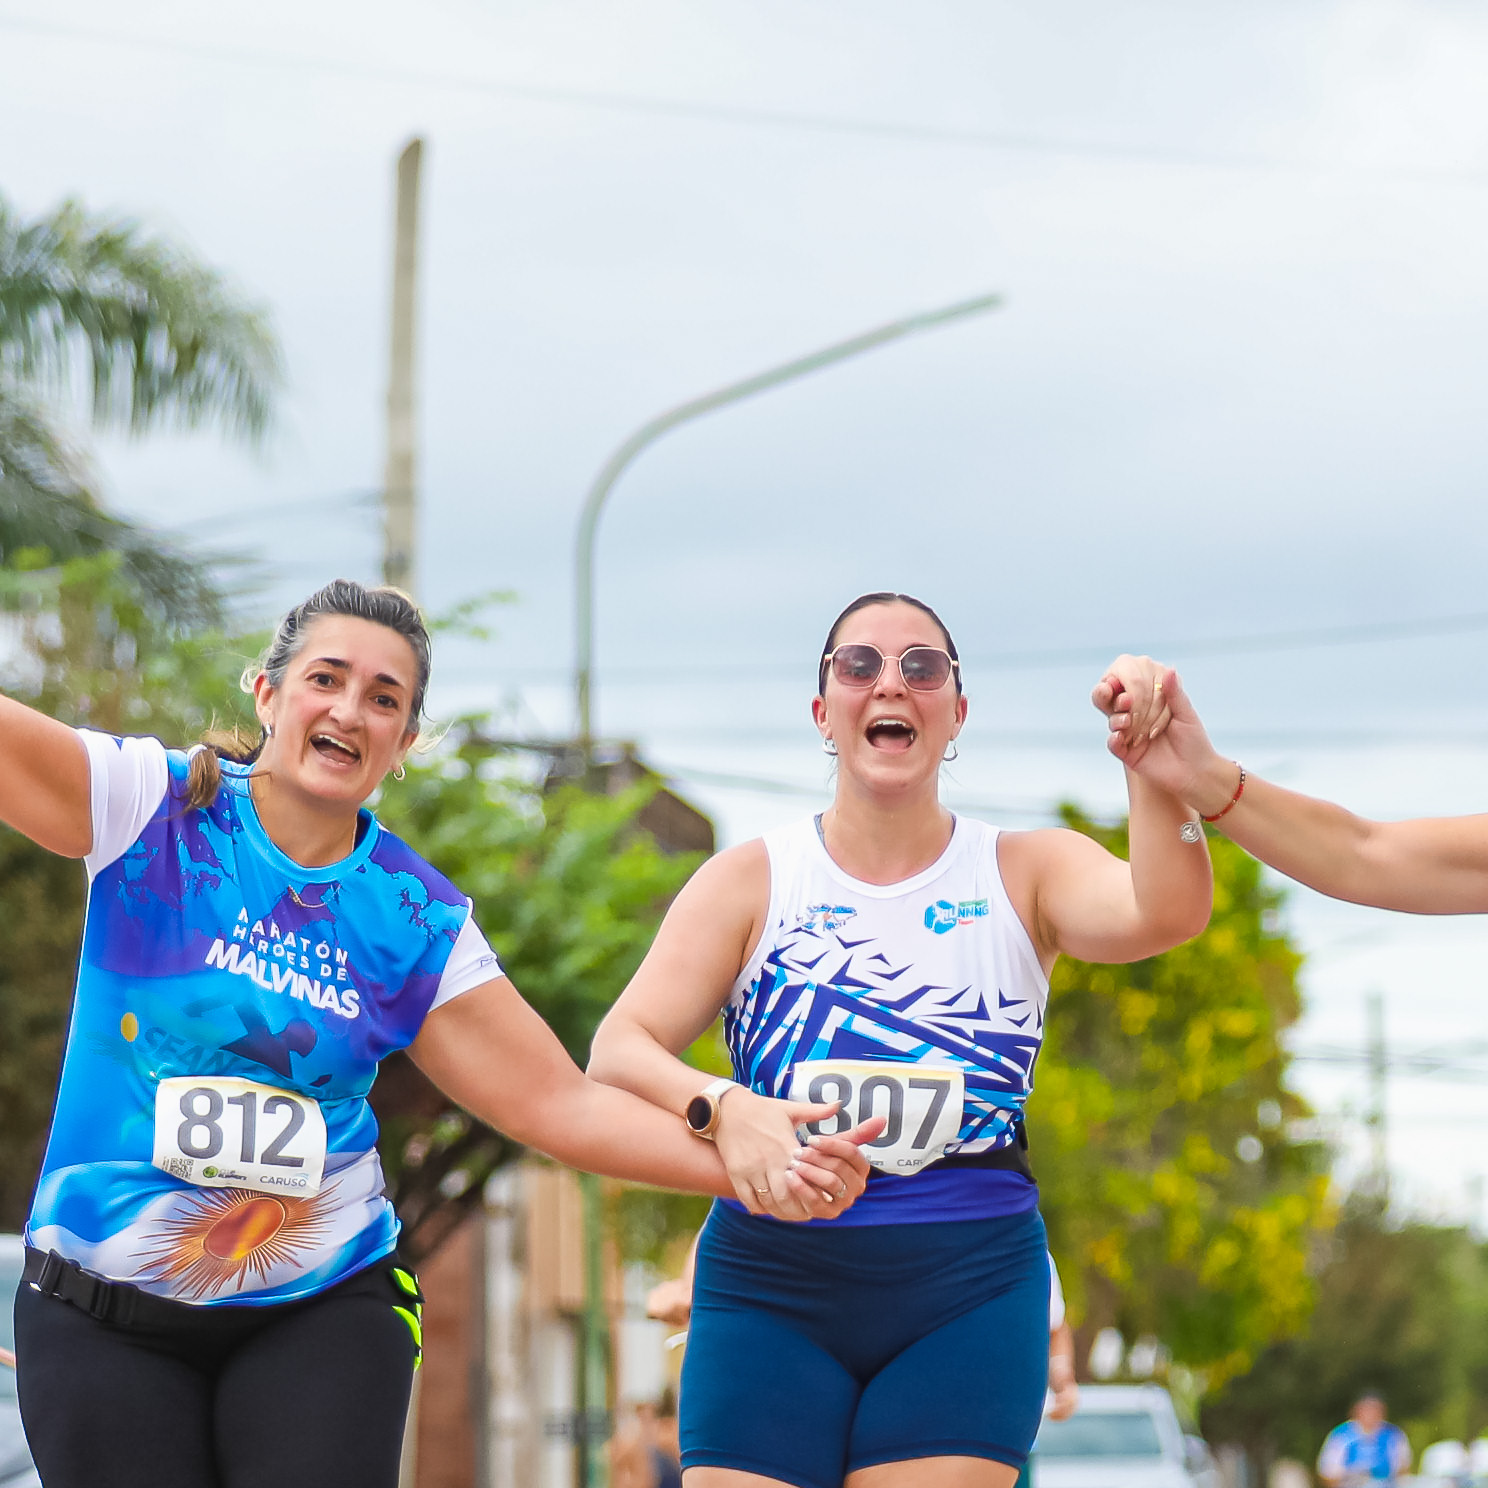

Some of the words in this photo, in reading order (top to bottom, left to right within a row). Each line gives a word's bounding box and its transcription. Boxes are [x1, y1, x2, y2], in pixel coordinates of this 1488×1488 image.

[204, 938, 360, 1019] MALVINAS
[320, 963, 348, 982] DE
[177, 1087, 305, 1167] 812
[806, 1073, 951, 1150] 807
[259, 1175, 307, 1187] CARUSO
